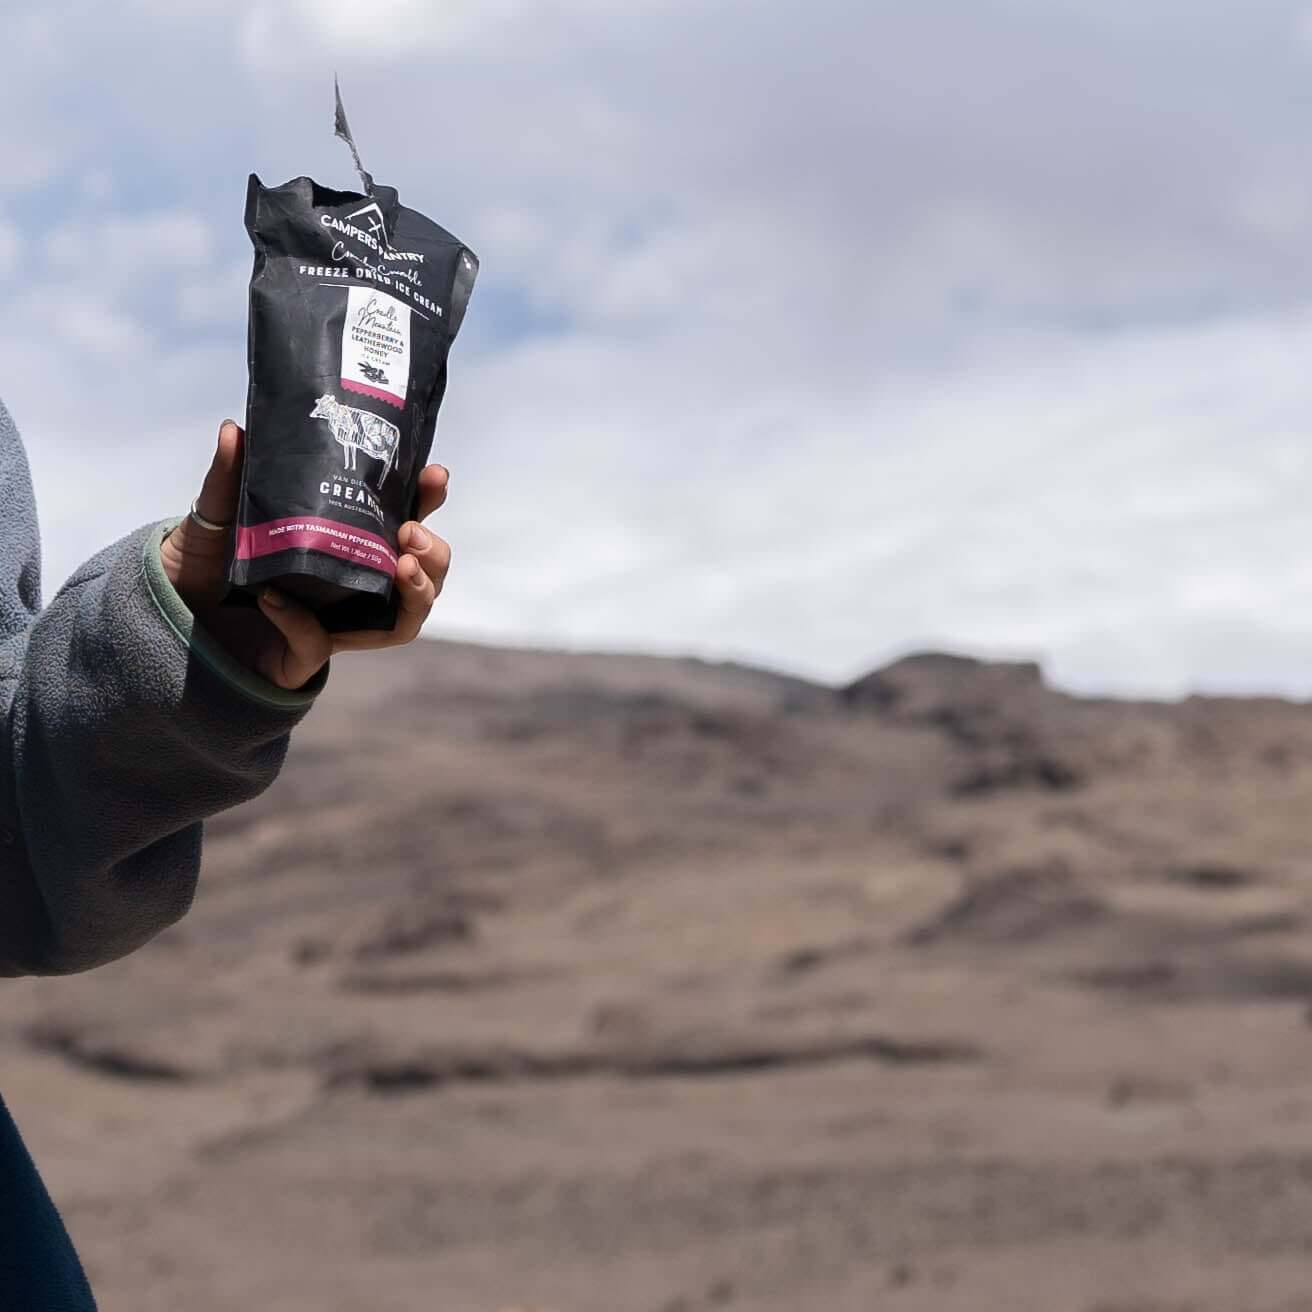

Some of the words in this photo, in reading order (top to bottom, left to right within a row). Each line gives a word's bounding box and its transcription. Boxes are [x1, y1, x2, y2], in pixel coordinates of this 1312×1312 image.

[320, 214, 378, 250] CAMPERS
[378, 245, 424, 264] PANTRY
[299, 265, 349, 278] FREEZE
[355, 267, 391, 286] DRIED
[395, 281, 410, 297] ICE
[413, 291, 443, 317] CREAM
[351, 326, 399, 346] PEPPERBERRY
[351, 334, 404, 355] LEATHERWOOD
[364, 346, 388, 358] HONEY
[333, 474, 349, 483] VAN
[269, 526, 285, 537] MADE
[286, 524, 304, 532] WITH
[306, 523, 349, 541] TASMANIAN
[330, 541, 341, 551] Net
